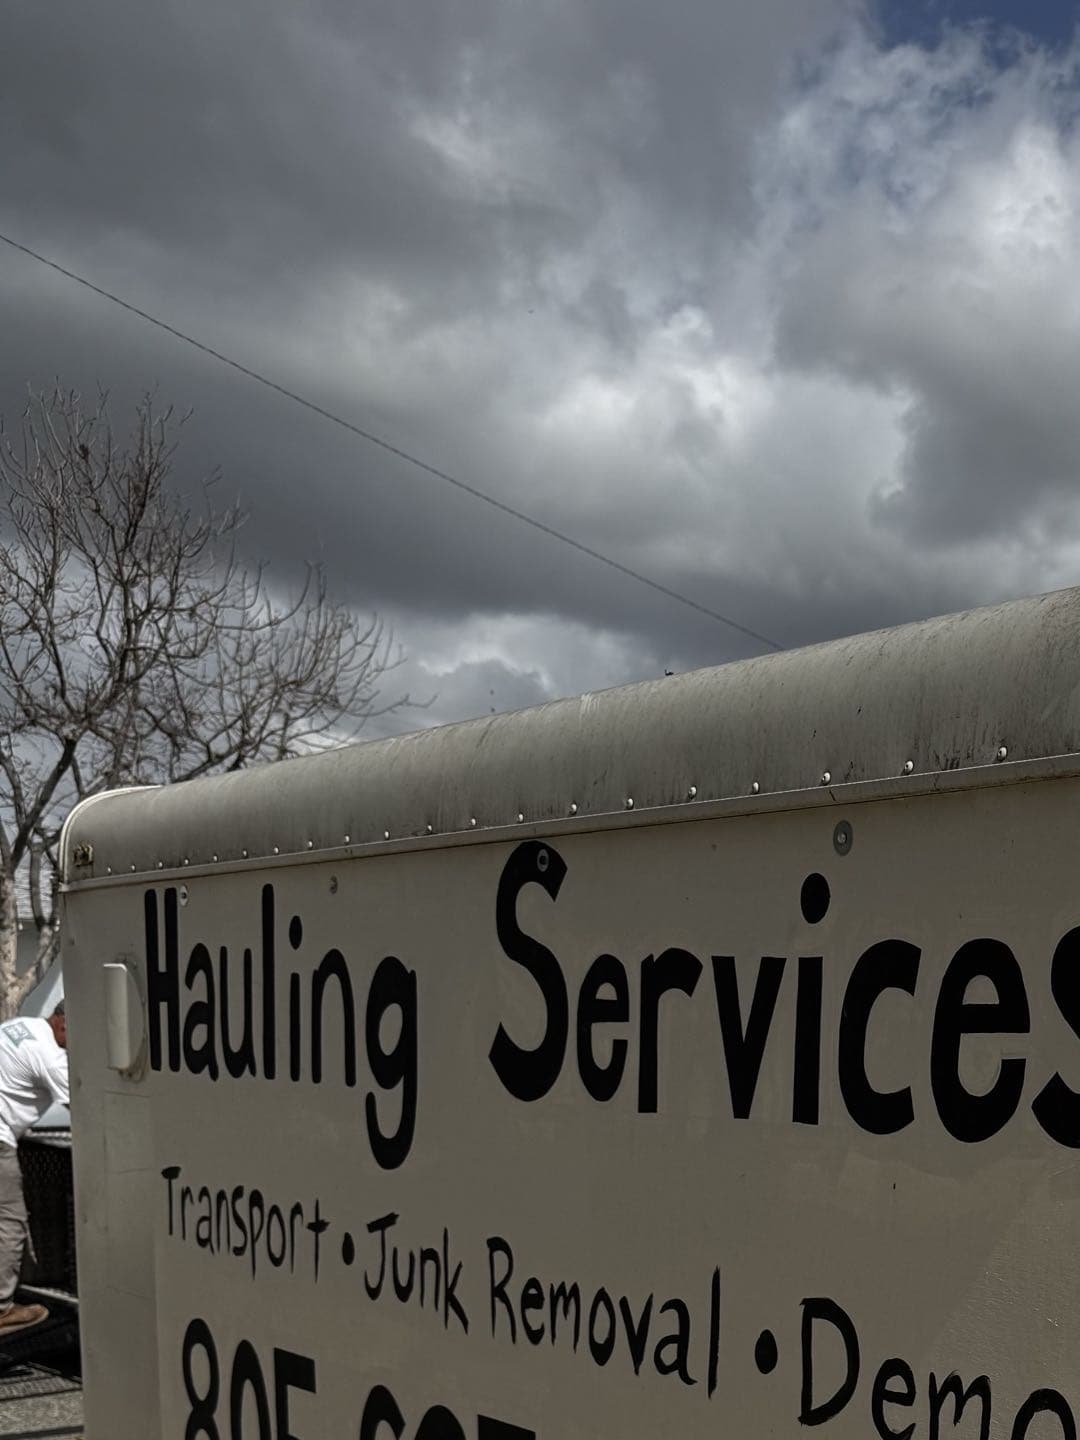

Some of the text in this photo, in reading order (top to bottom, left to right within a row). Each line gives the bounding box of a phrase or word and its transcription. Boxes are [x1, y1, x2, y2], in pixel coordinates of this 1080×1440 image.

[143, 883, 418, 1171] Hauling
[161, 1166, 330, 1282] Transport
[363, 1211, 469, 1335] Junk
[485, 1235, 721, 1400] Removal
